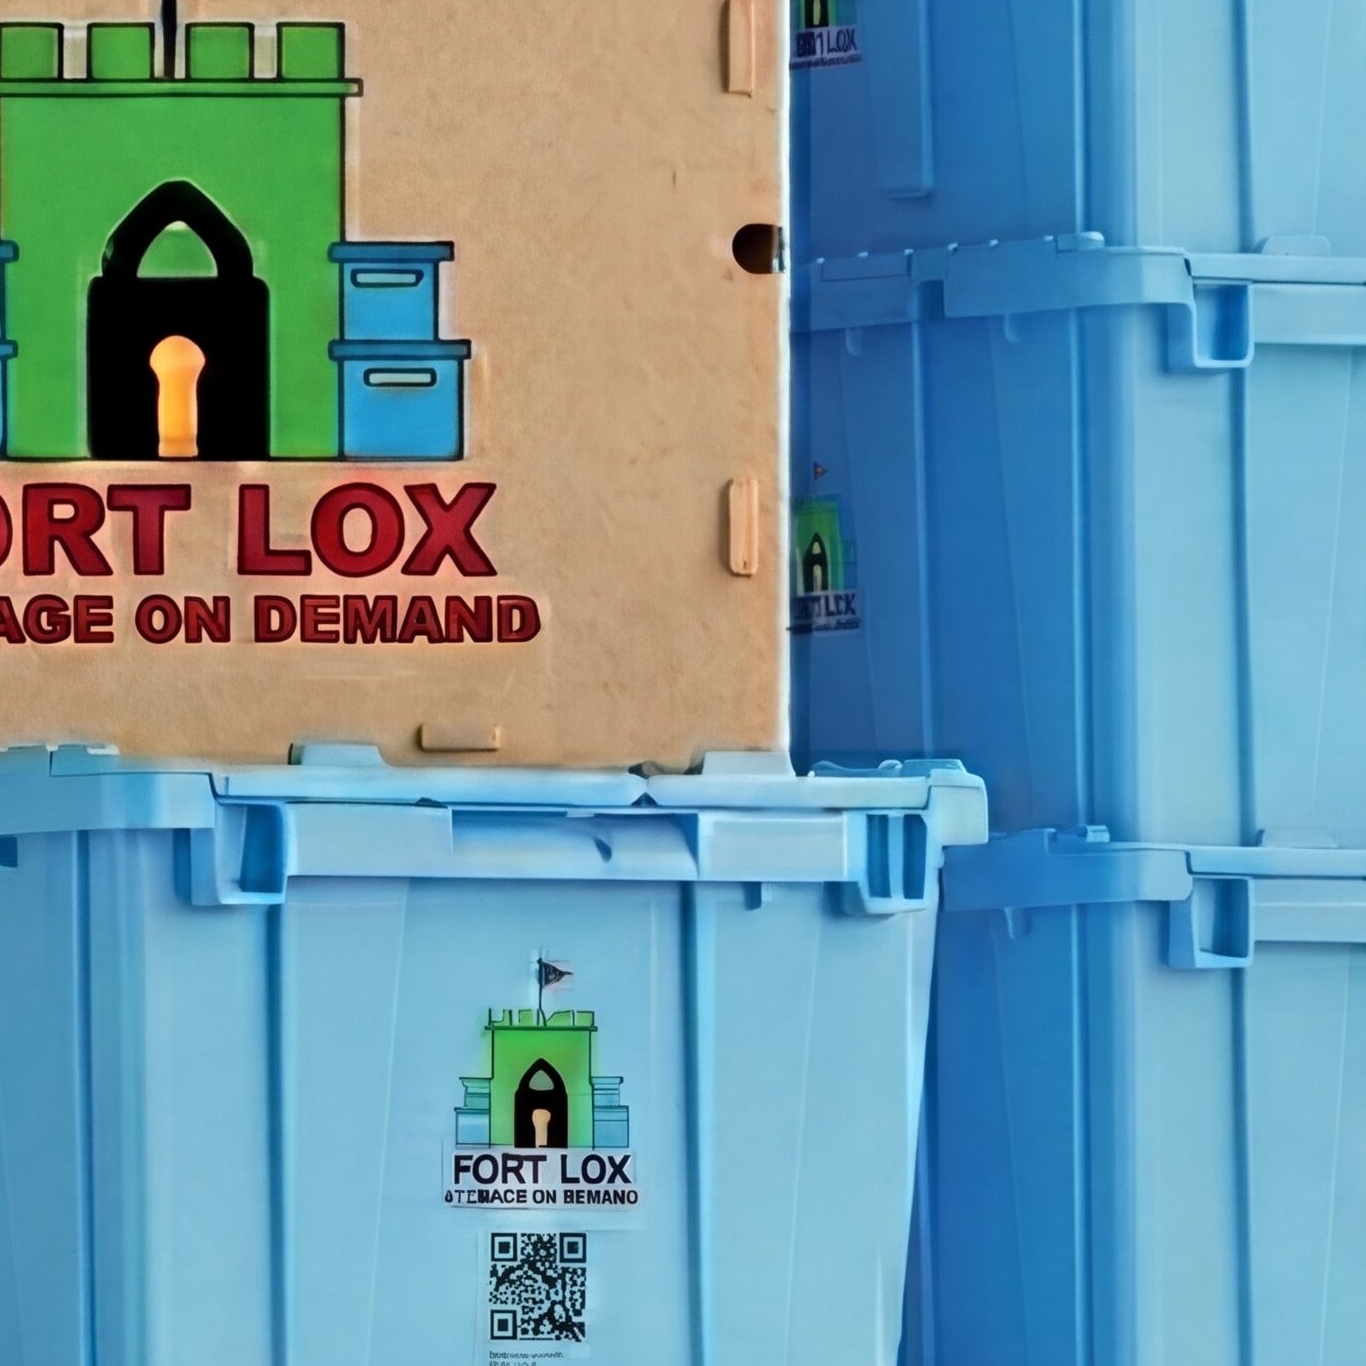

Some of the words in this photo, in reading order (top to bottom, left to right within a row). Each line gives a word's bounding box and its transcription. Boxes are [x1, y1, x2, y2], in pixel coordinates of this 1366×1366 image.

[237, 482, 498, 577] LOX
[135, 594, 231, 644] ON
[254, 594, 542, 644] DEMAND
[454, 1153, 547, 1184] FORT
[561, 1154, 632, 1184] LOX
[532, 1189, 557, 1204] ON
